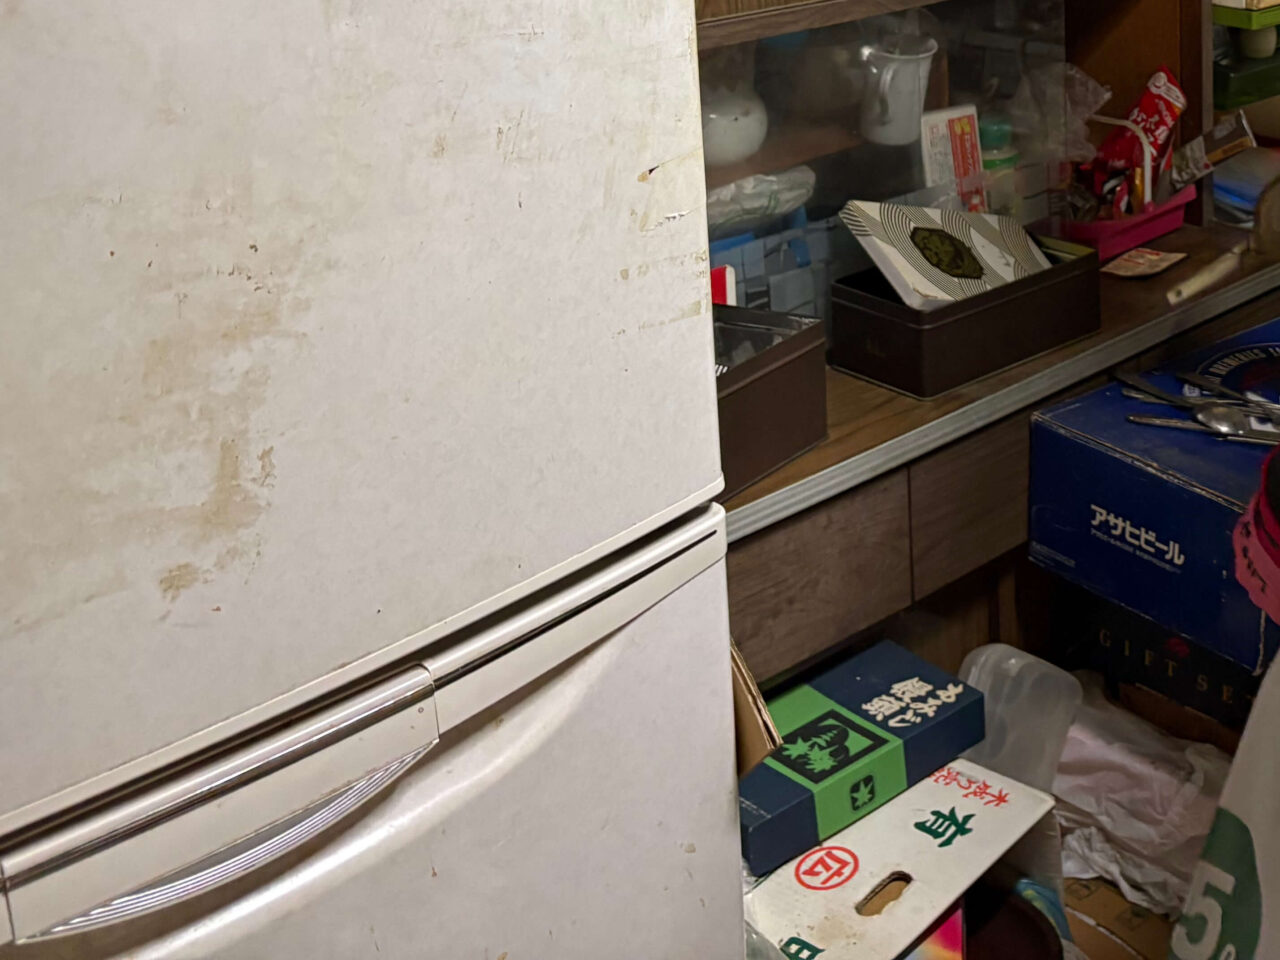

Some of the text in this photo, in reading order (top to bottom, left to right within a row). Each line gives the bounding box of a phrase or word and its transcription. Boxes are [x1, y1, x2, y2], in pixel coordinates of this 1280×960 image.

[1089, 503, 1186, 566] アサヒビール
[1099, 628, 1177, 678] GIFT
[928, 764, 1010, 808] 木成り完
[912, 806, 978, 848] 有
[799, 849, 853, 887] 広
[1170, 858, 1236, 960] 5
